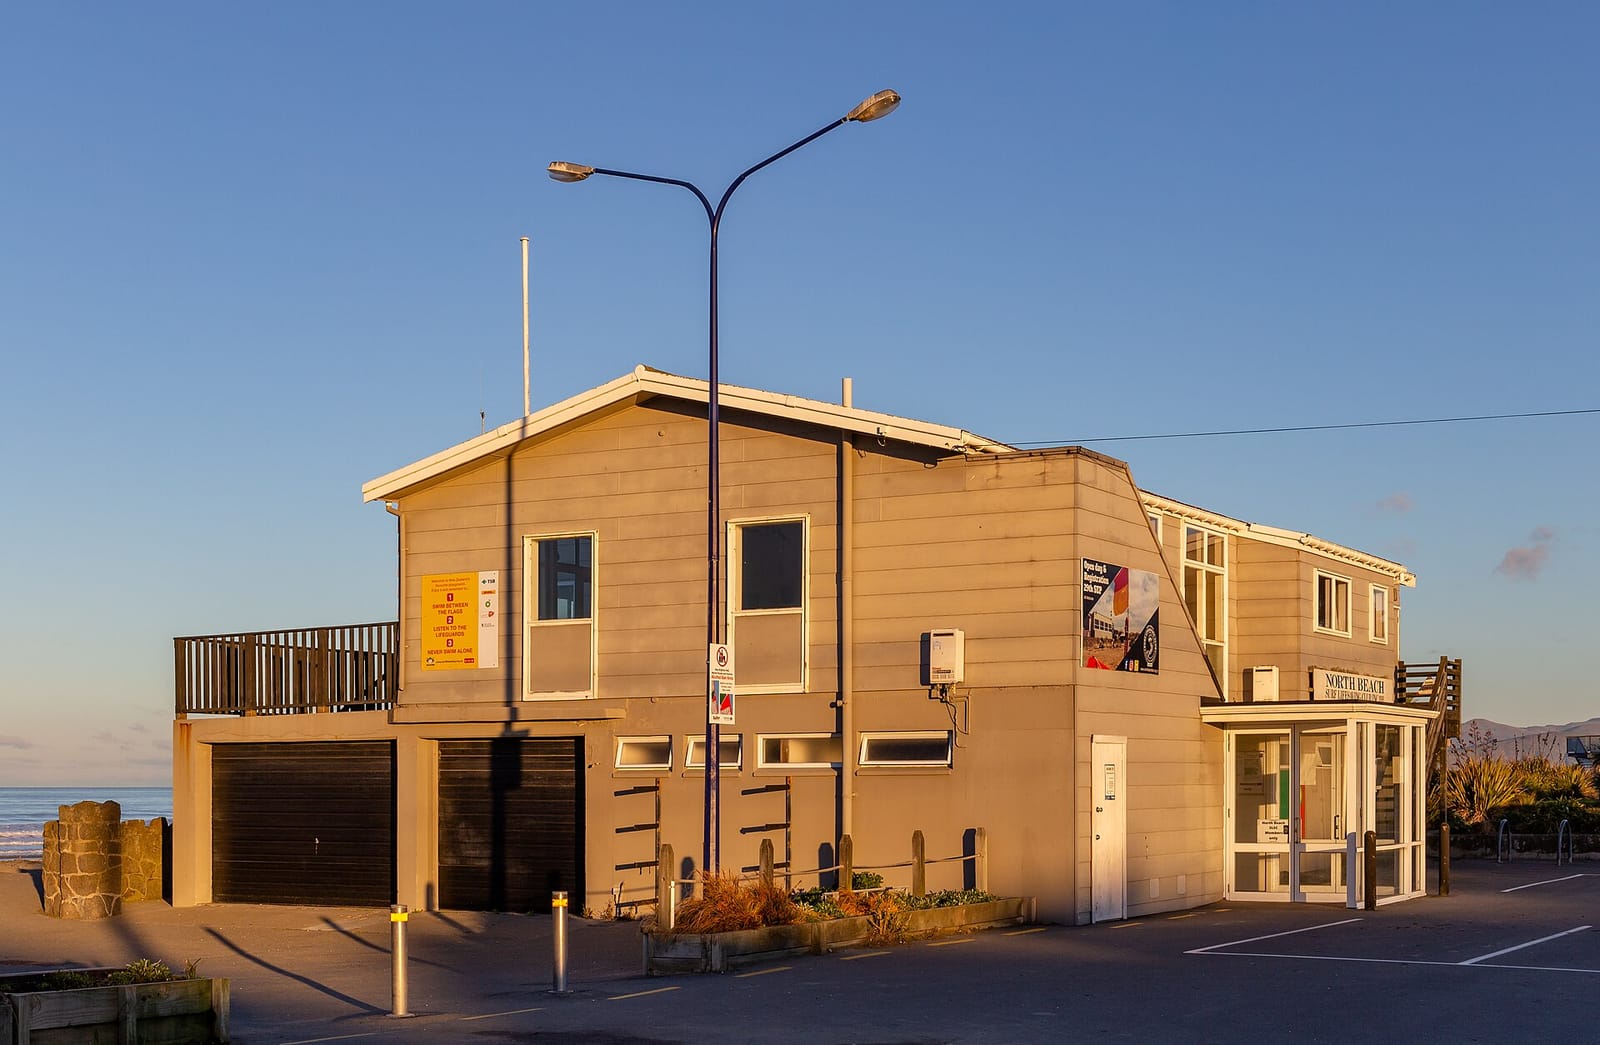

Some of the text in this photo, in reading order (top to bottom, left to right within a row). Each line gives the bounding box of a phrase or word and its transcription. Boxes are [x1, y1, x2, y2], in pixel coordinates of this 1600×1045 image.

[1084, 560, 1094, 571] Open
[1084, 572, 1109, 584] Registration
[1084, 584, 1093, 592] 29th
[1325, 673, 1384, 694] NORTH BEACH
